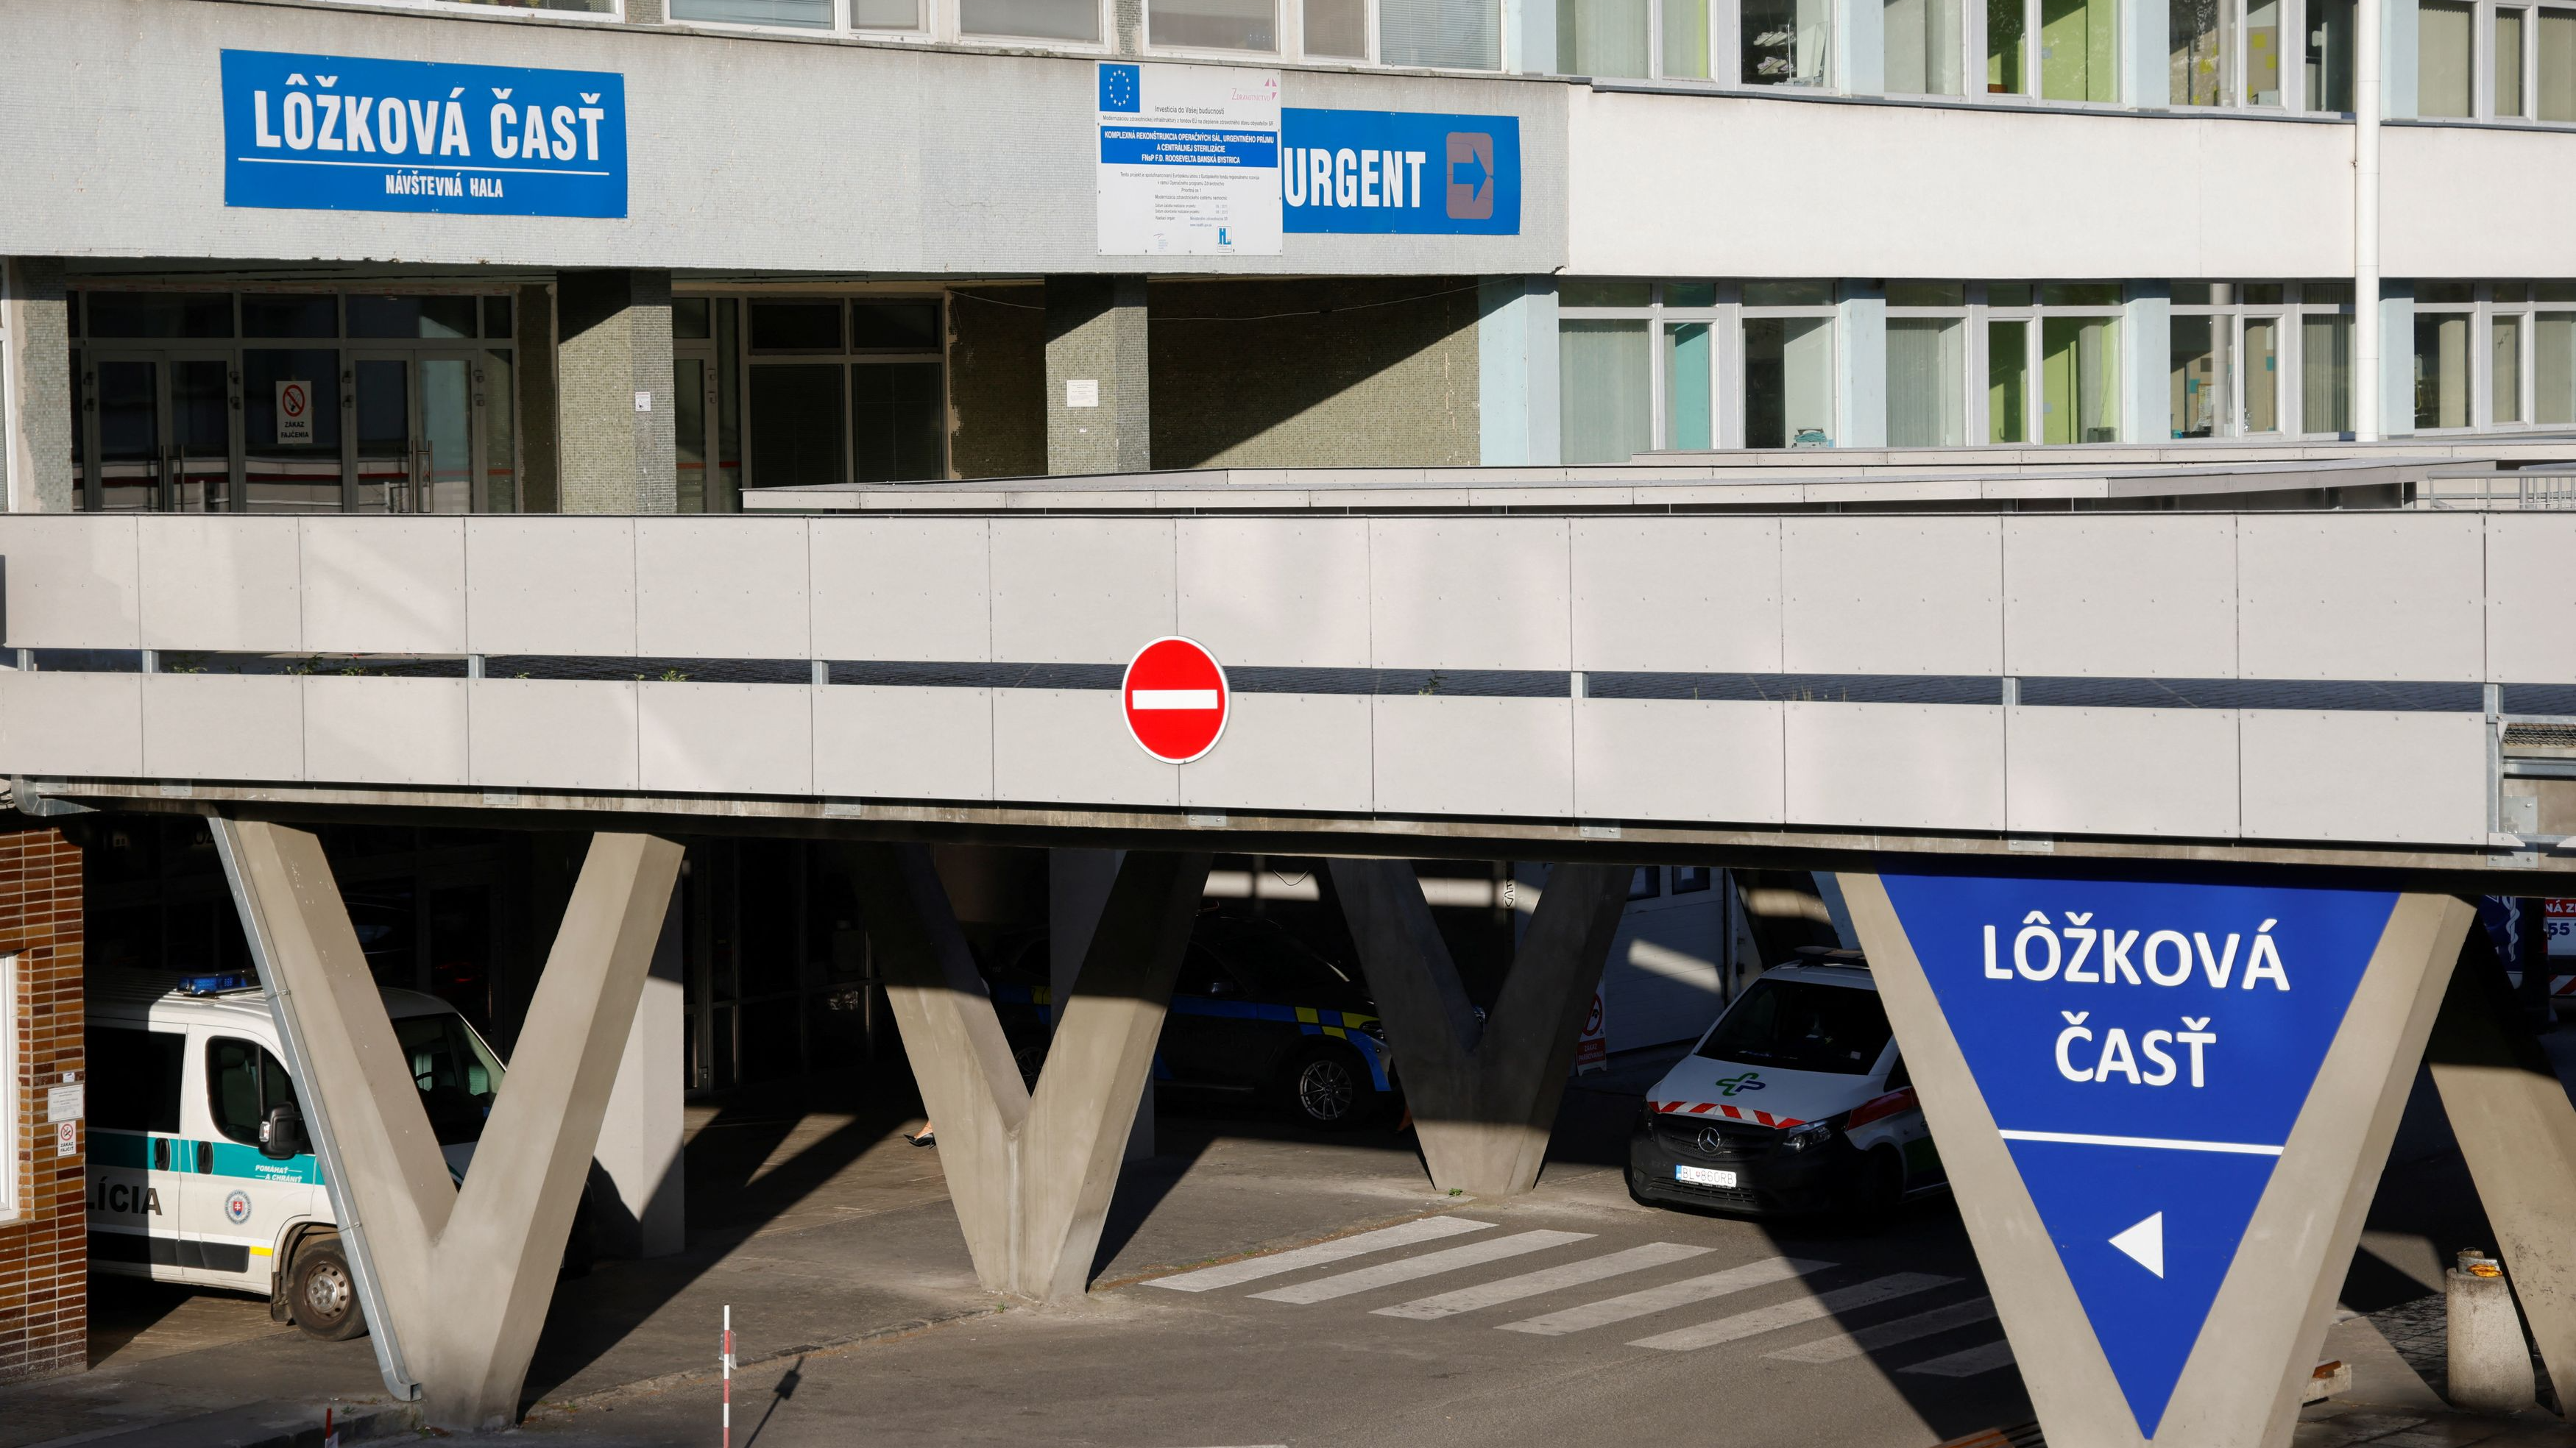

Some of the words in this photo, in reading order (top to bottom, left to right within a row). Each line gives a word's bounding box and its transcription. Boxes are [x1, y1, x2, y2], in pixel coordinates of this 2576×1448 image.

[253, 73, 470, 157] LÔŽKOVÁ
[489, 88, 604, 160] ČASŤ
[1185, 107, 1197, 115] Vašej
[1105, 130, 1136, 139] KOMPLEXNÁ
[1136, 131, 1178, 141] REKONŠTRUKCIA
[1178, 132, 1211, 141] OPERAČNÝCH
[1211, 132, 1222, 143] SÁL,
[1223, 134, 1256, 143] URGENTNÉHO
[1256, 134, 1274, 143] PRÍJMU
[1161, 142, 1193, 152] CENTRÁLNEJ
[1194, 143, 1225, 152] STERILIZÁCIE
[1155, 154, 1164, 162] F.D.
[1165, 155, 1197, 163] ROOSEVELTA
[1197, 155, 1217, 163] BANSKÁ
[1217, 156, 1240, 164] BYSTRICA
[1284, 147, 1426, 207] URGENT
[386, 170, 463, 196] NÁVŠTEVNÁ
[470, 177, 503, 198] HALA
[1983, 910, 2290, 992] LÔŽKOVÁ
[2054, 1010, 2218, 1088] ČASŤ
[255, 1165, 289, 1174] POMÁHAŤ
[272, 1174, 302, 1183] CHRÁNIŤ
